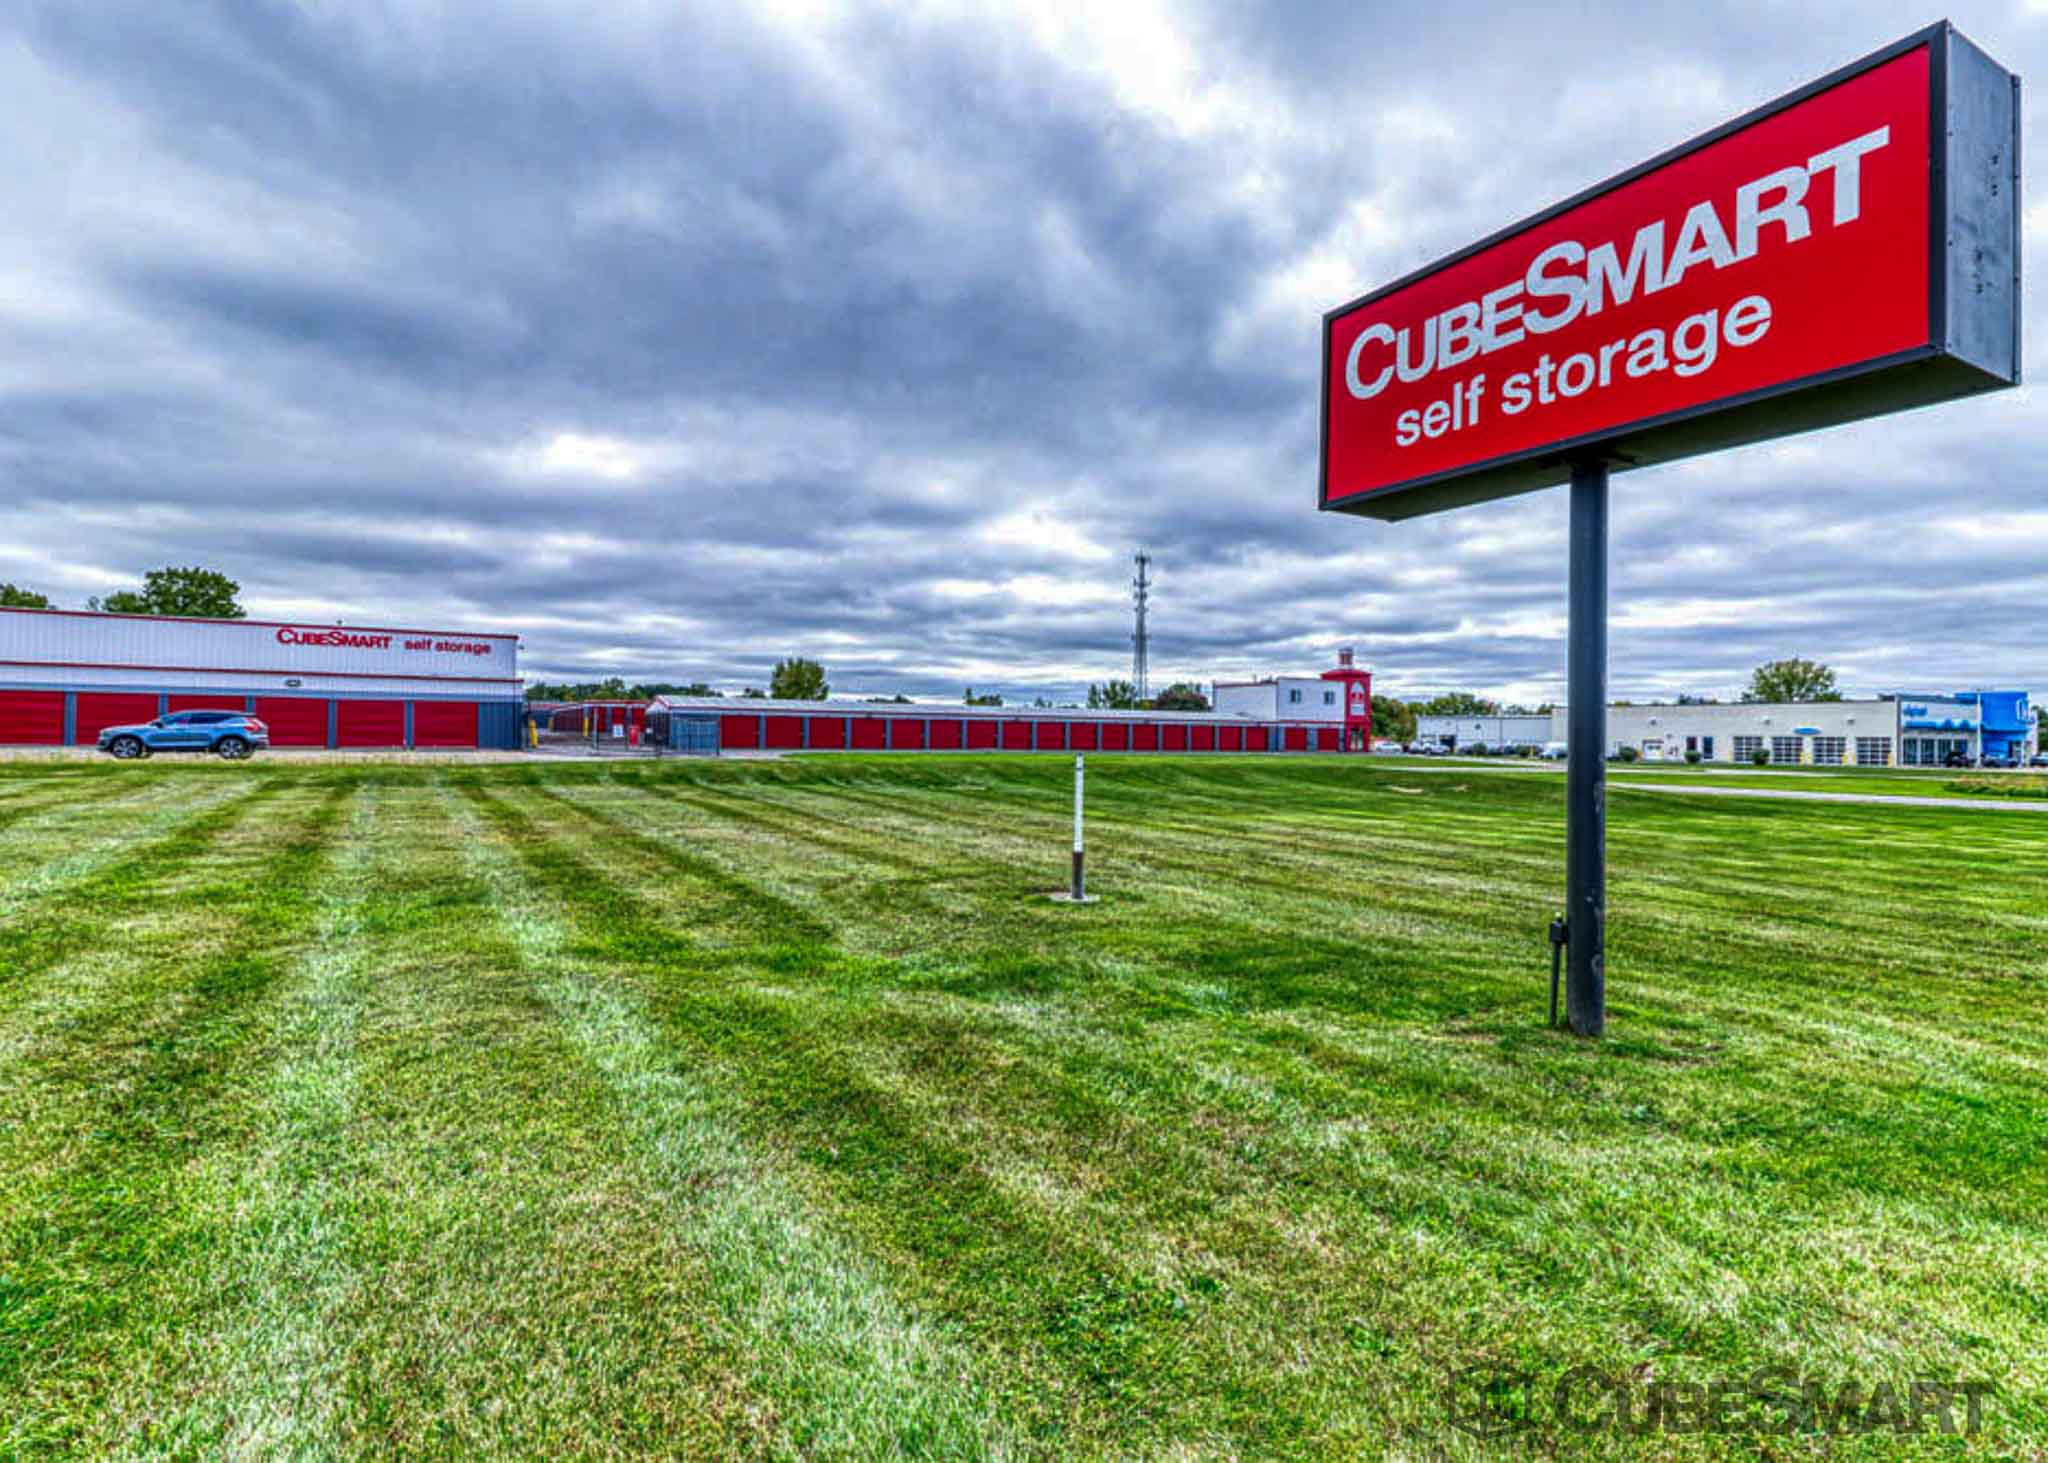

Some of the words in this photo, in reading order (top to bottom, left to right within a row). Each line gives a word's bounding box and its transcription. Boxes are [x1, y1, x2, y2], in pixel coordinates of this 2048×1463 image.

[1345, 125, 1890, 400] CUBESMART
[1396, 373, 1486, 447] self
[1501, 294, 1772, 415] storage
[276, 626, 392, 649] CUBESMART
[404, 638, 431, 651] self
[434, 641, 492, 656] storage
